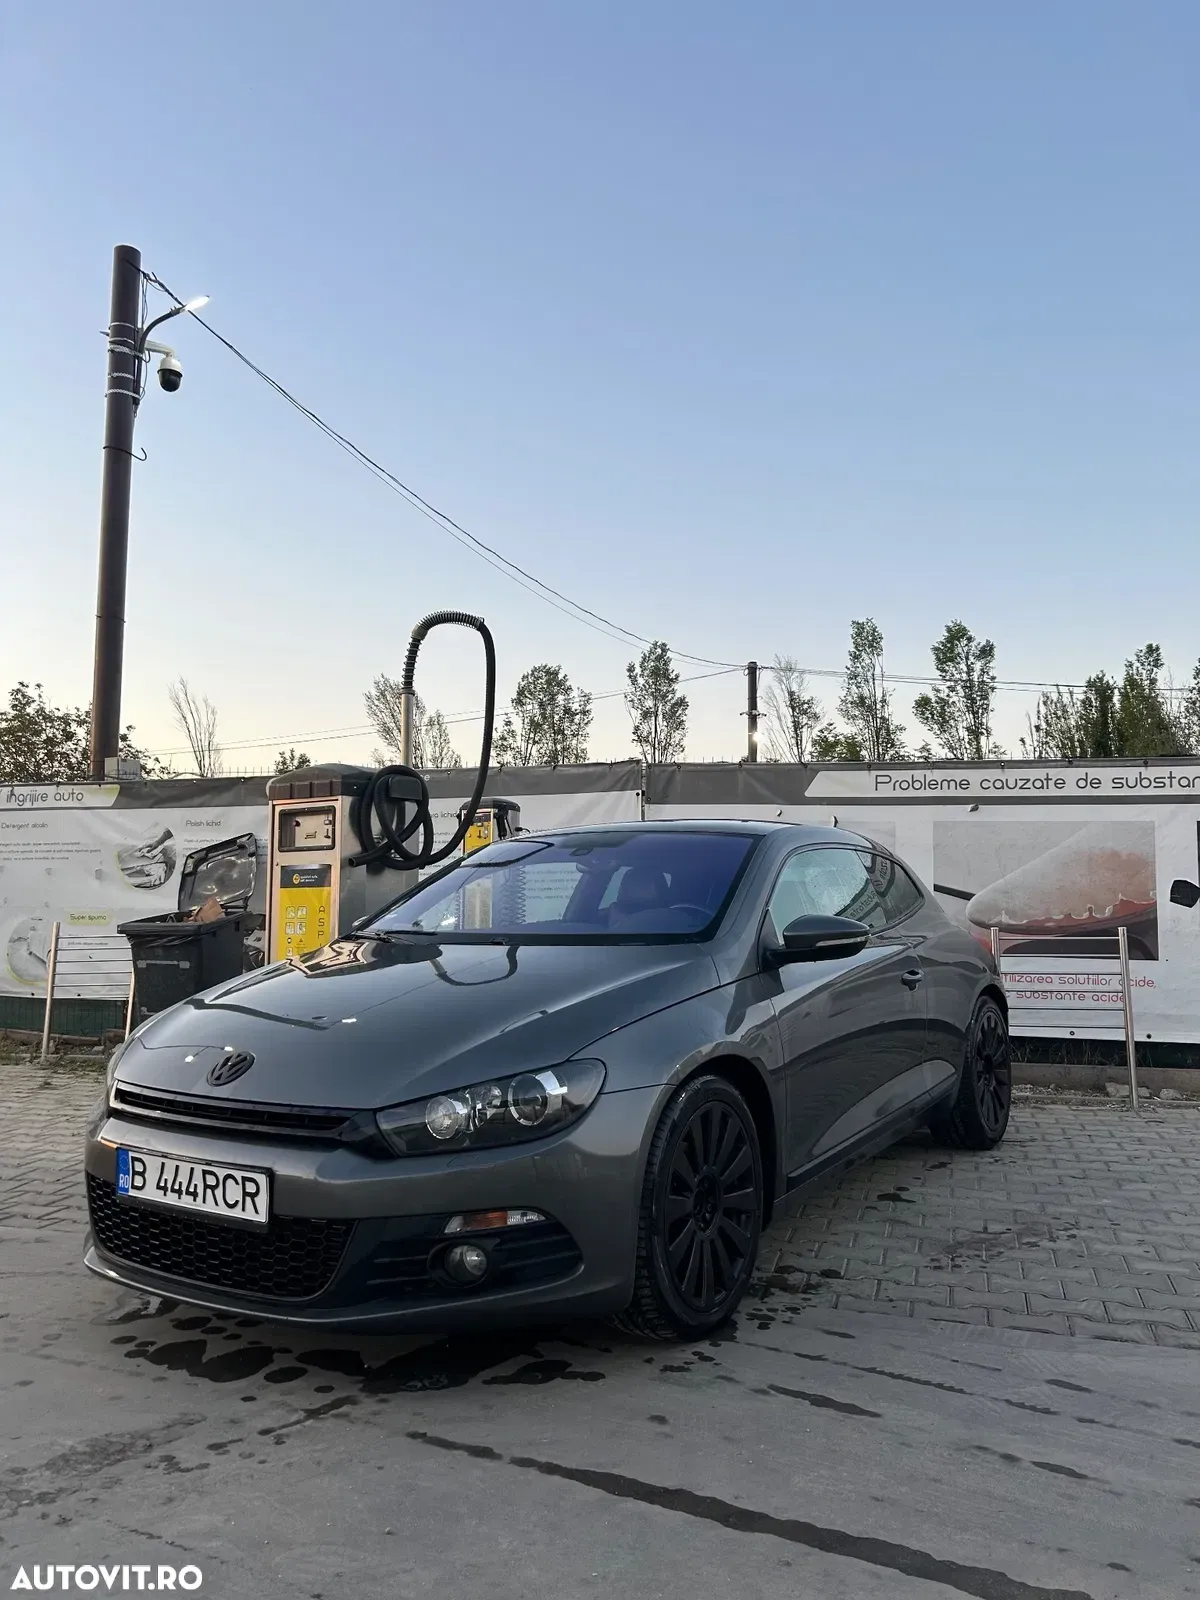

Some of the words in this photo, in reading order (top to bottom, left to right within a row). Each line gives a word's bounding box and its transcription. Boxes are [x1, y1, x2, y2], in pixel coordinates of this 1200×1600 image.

[874, 774, 971, 791] Probleme
[979, 772, 1067, 790] cauzate
[1076, 772, 1102, 789] de
[53, 787, 84, 802] auto
[1001, 973, 1054, 985] tilizarea
[1058, 974, 1113, 987] solutiilor
[119, 1173, 129, 1189] RO
